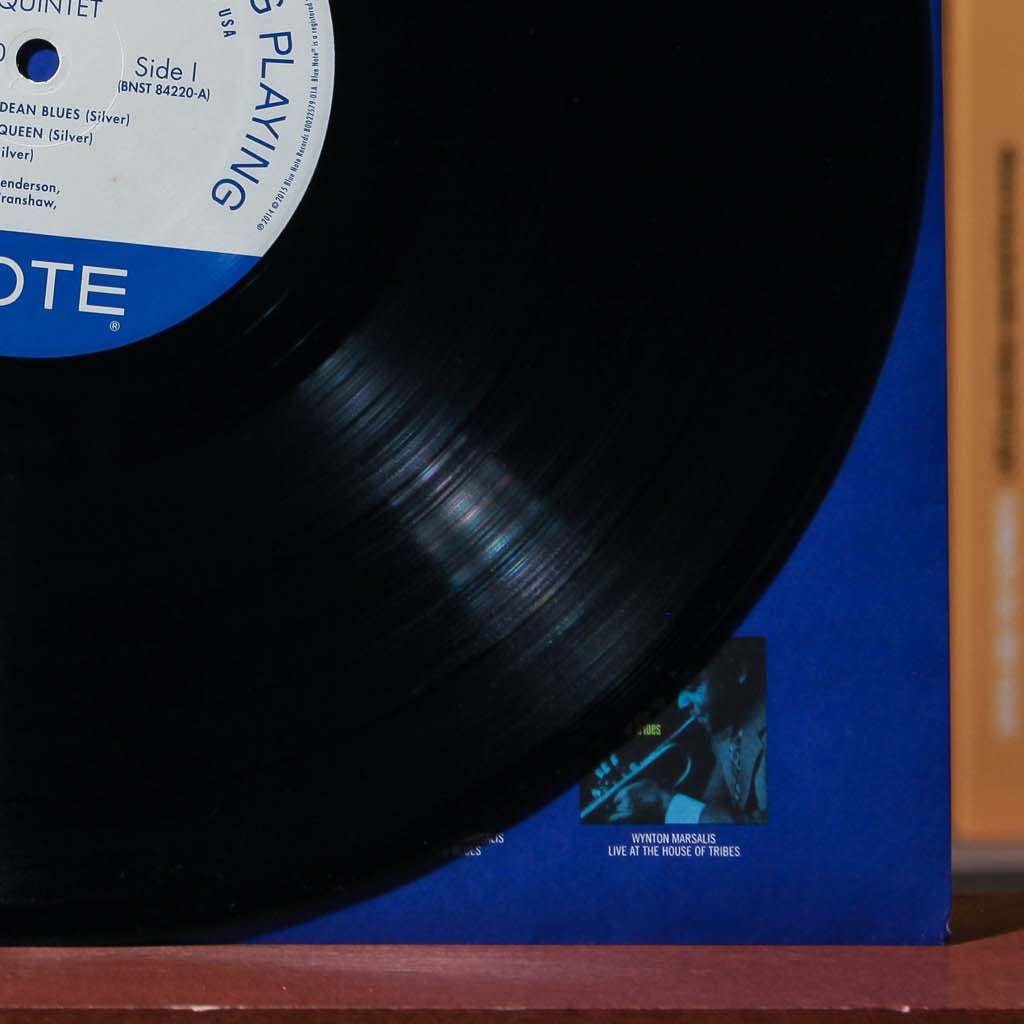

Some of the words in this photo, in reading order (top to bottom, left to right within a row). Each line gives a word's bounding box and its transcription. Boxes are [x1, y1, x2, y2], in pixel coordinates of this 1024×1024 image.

[218, 8, 237, 38] USA
[135, 56, 183, 81] Side
[118, 80, 151, 95] (BNST
[155, 83, 210, 102] 84220-A)
[42, 106, 81, 120] BLUES
[85, 110, 130, 126] (Silver)
[211, 31, 295, 211] PLAYING
[48, 129, 93, 145] (Silver)
[295, 134, 310, 157] Records
[290, 158, 302, 173] Note
[283, 173, 295, 187] Blue
[631, 833, 669, 844] WYNTON
[671, 833, 717, 844] MARSALIS
[608, 845, 627, 856] LIVE
[629, 845, 639, 856] AT
[642, 845, 659, 856] THE
[662, 845, 692, 856] HOUSE
[694, 846, 706, 857] OF
[709, 846, 741, 857] TRIBES
